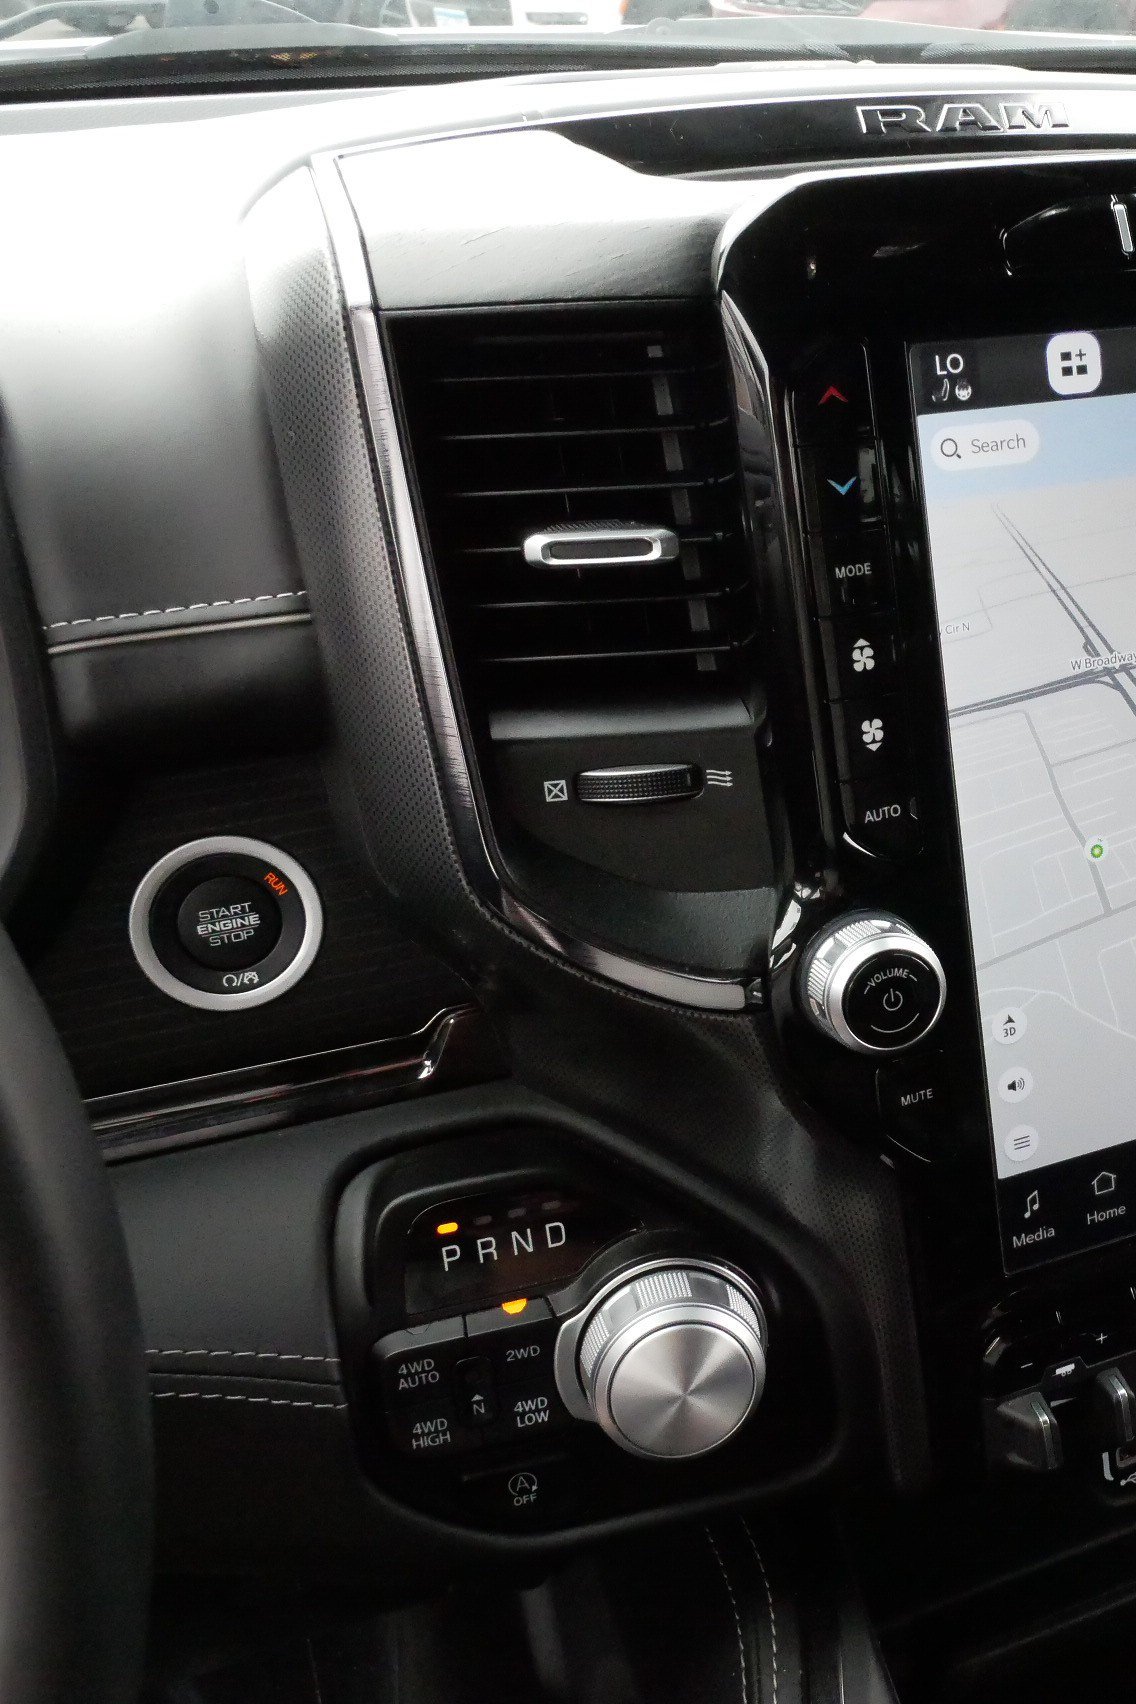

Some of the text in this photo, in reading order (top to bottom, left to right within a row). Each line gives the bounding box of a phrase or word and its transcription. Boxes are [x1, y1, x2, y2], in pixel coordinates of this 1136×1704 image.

[856, 102, 1070, 134] RAM
[935, 353, 964, 376] LO
[970, 433, 1027, 454] Search
[835, 562, 872, 579] MODE
[945, 621, 971, 635] Cir N
[1070, 658, 1083, 671] W
[864, 804, 901, 824] AUTO
[263, 872, 288, 896] RUN
[198, 902, 252, 920] START
[196, 914, 260, 935] ENGINE
[209, 929, 254, 947] STOP
[867, 968, 909, 987] VOLUME
[1002, 1026, 1016, 1038] 3D
[901, 1088, 934, 1106] MUTE
[1087, 1204, 1126, 1226] Home
[1012, 1225, 1055, 1248] Media
[441, 1221, 566, 1272] P R N D
[505, 1345, 541, 1362] 2WD
[398, 1358, 435, 1375] 4WD
[398, 1371, 440, 1391] AUTO
[472, 1402, 486, 1416] N
[513, 1396, 548, 1414] 4WD
[412, 1418, 448, 1435] 4WD
[516, 1409, 550, 1428] LOW
[411, 1430, 451, 1450] HIGH
[513, 1493, 537, 1507] OFF
